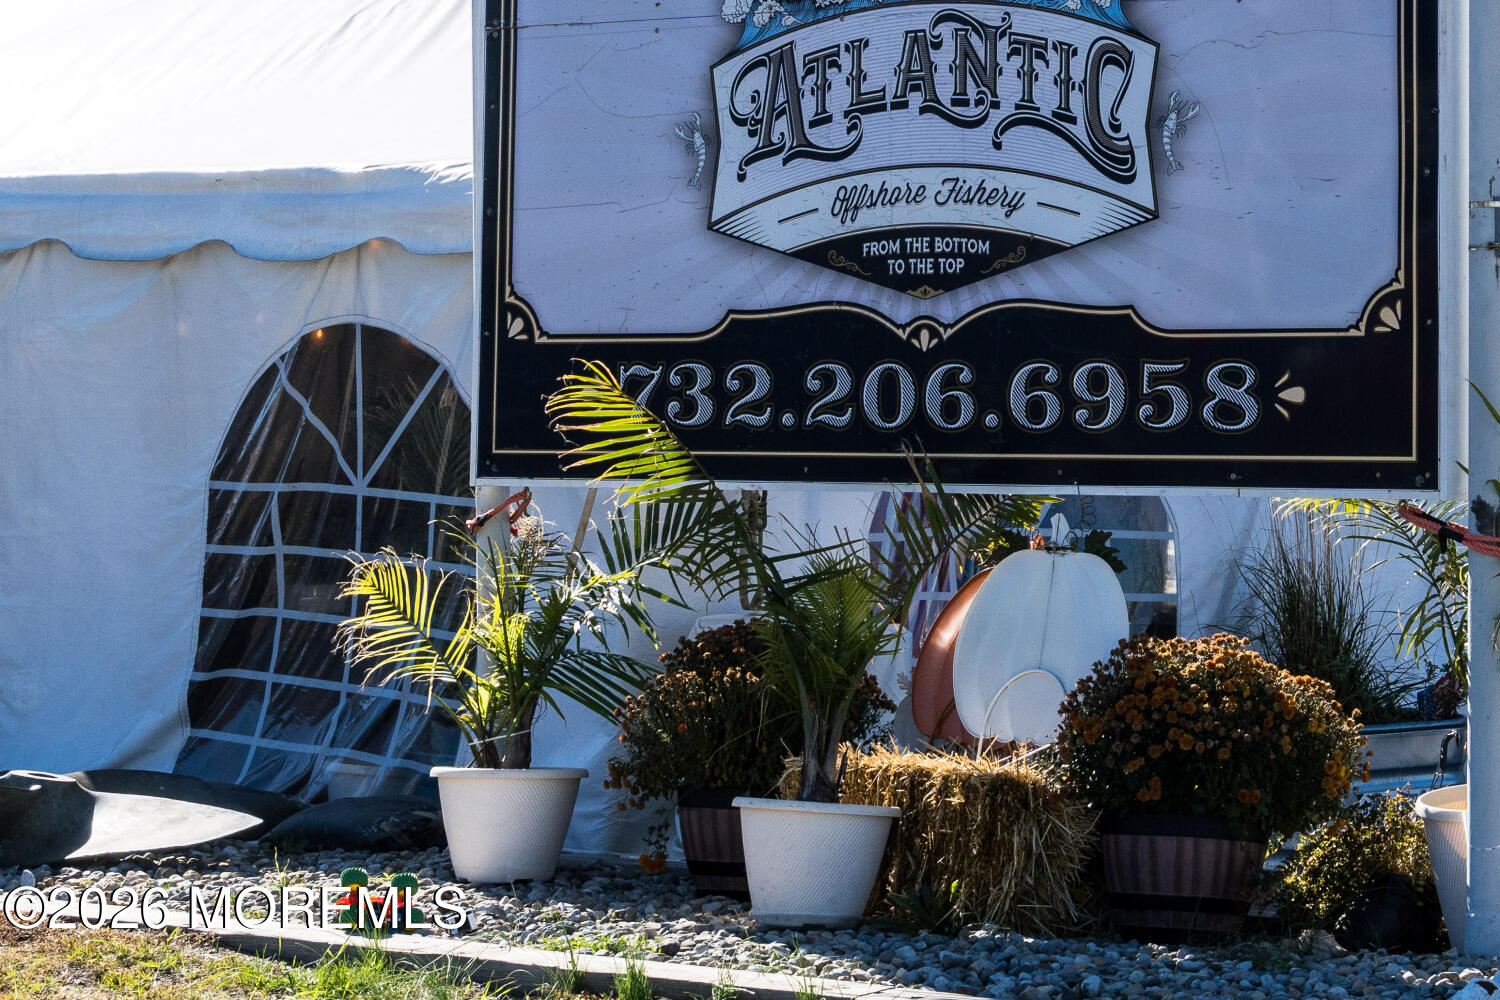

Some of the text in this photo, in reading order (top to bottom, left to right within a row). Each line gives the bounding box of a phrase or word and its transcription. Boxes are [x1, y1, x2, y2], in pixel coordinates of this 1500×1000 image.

[728, 7, 1138, 184] ATLANTIC
[830, 176, 1027, 225] Offshore Fishery
[862, 236, 991, 258] FROM THE BOTTOM
[887, 257, 965, 276] TO THE TOP
[618, 359, 1263, 431] 732.206.6958
